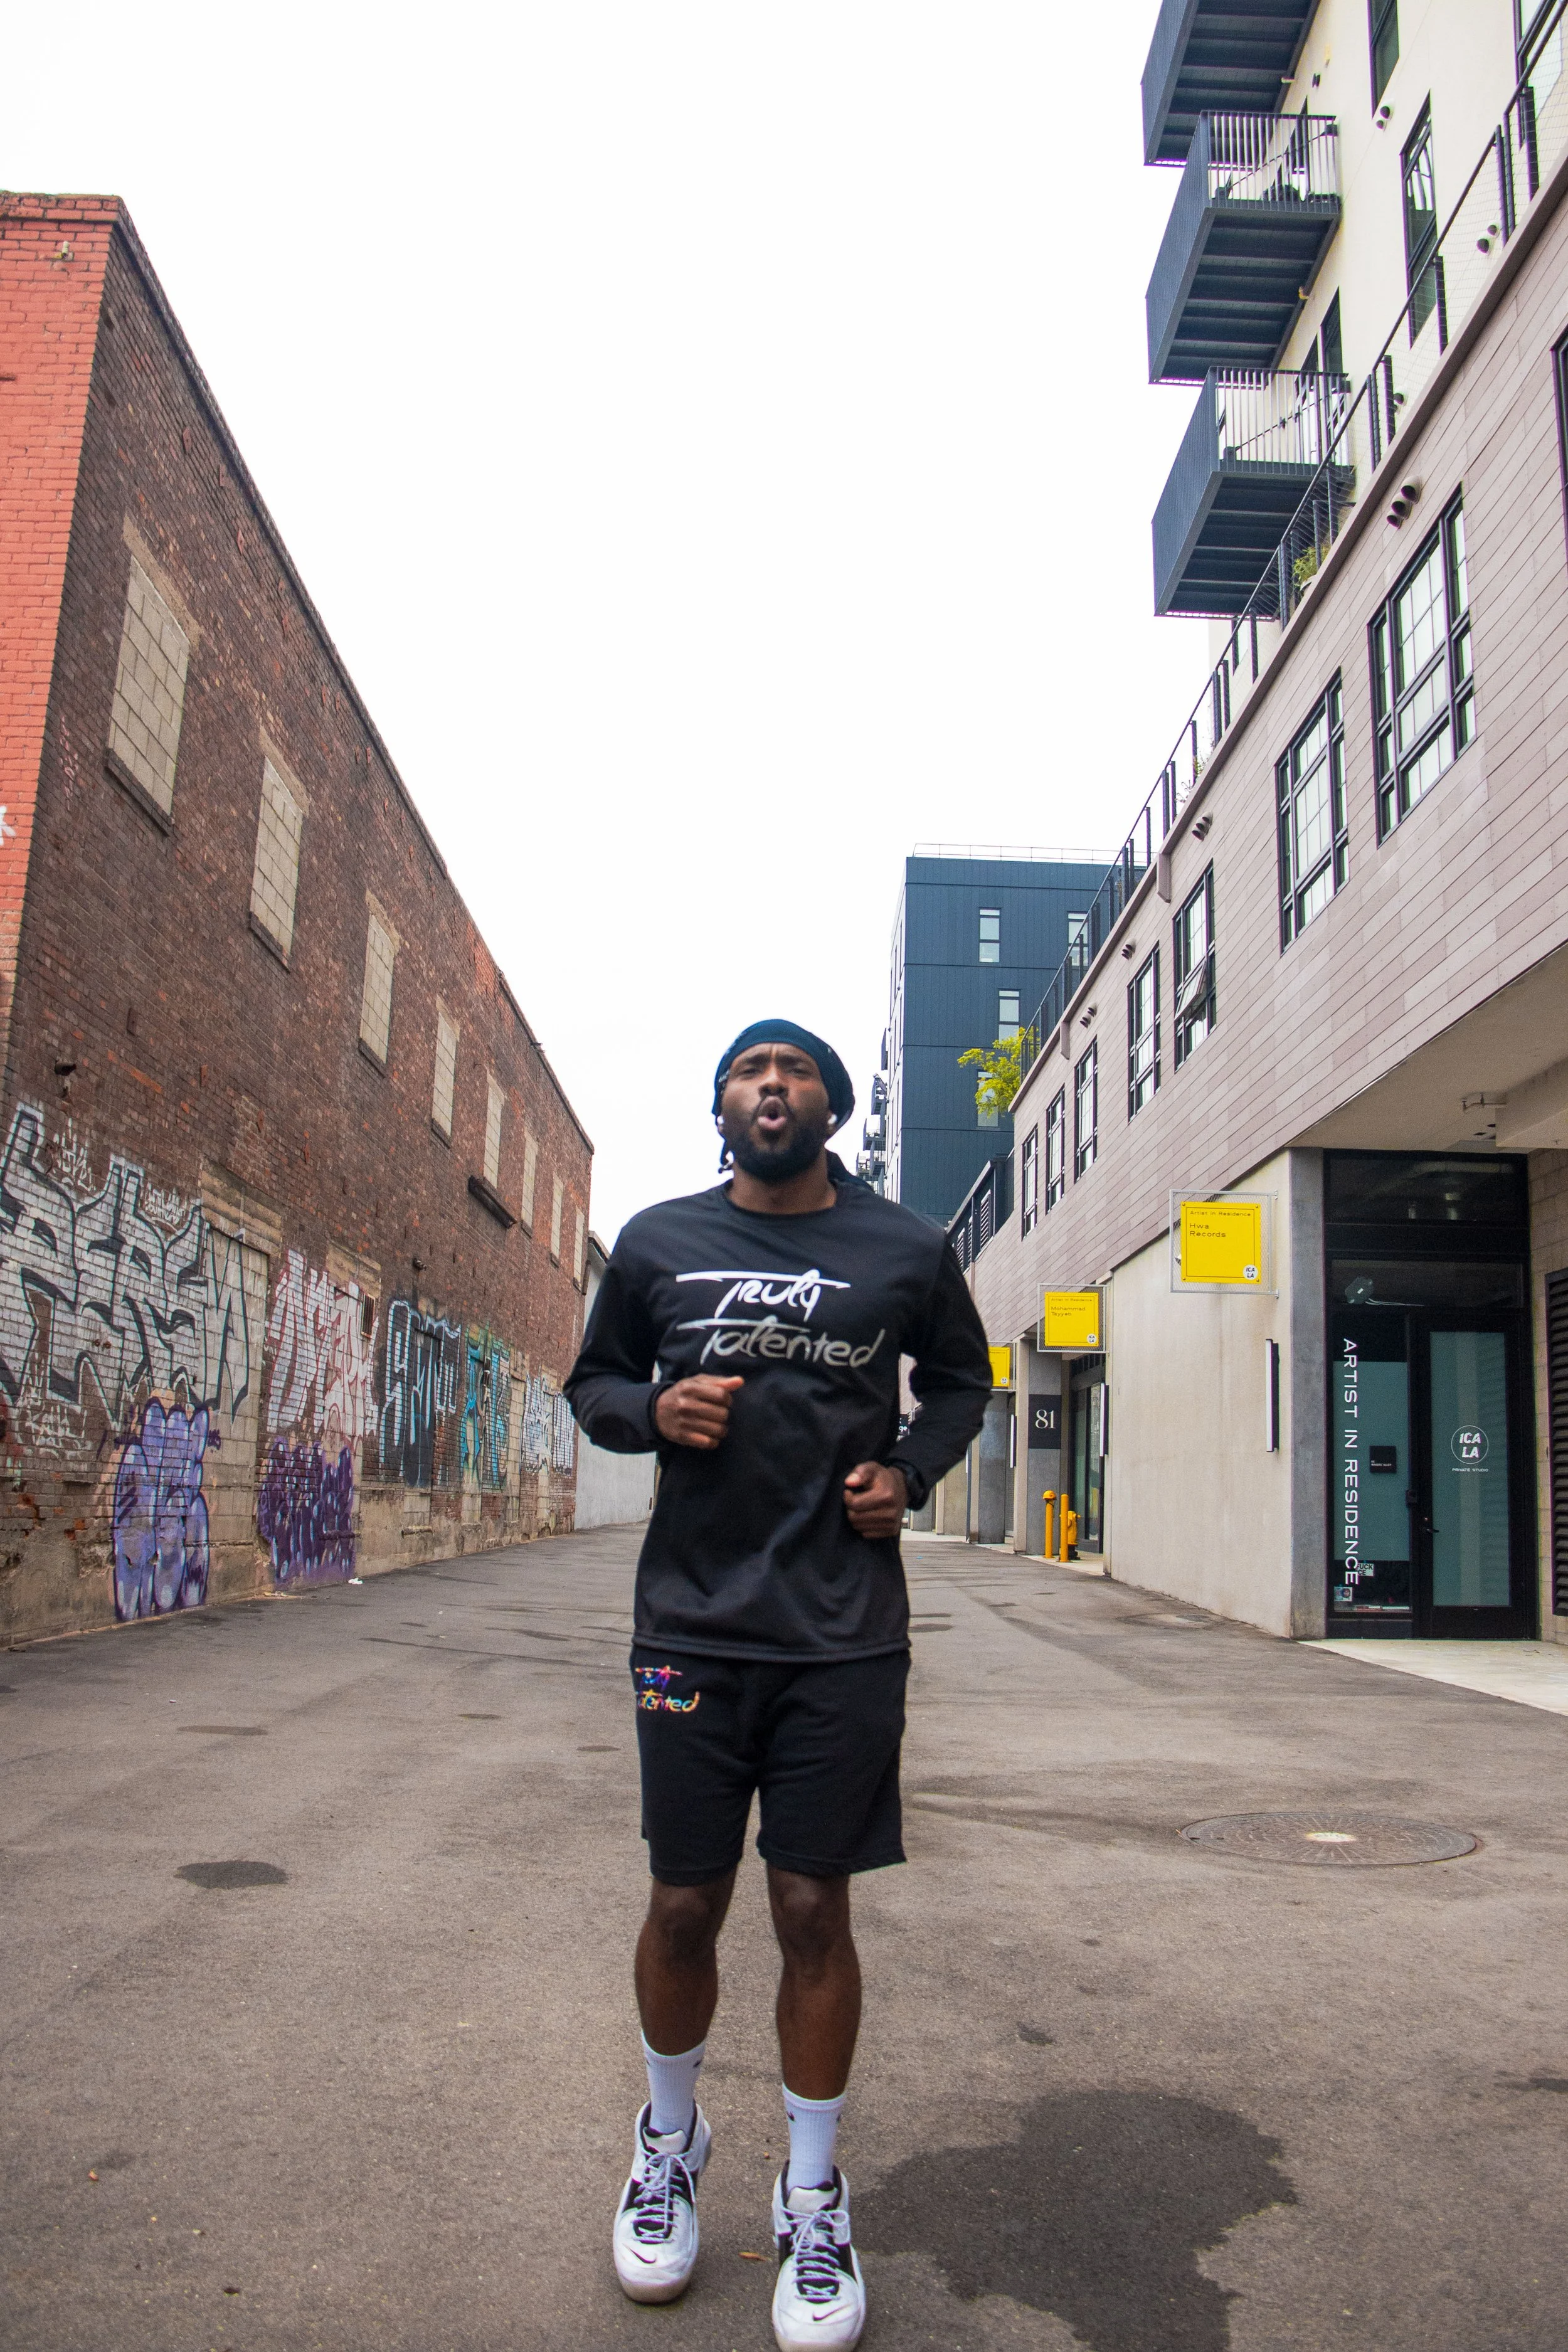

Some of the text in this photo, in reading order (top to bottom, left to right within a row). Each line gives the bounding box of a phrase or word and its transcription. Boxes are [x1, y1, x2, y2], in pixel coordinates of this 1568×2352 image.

[676, 1315, 886, 1367] Talented
[1035, 1409, 1056, 1429] 81
[1459, 1432, 1481, 1444] ICA
[1343, 1338, 1359, 1585] ARTIST IN RESIDENCE
[1462, 1446, 1479, 1458] LA
